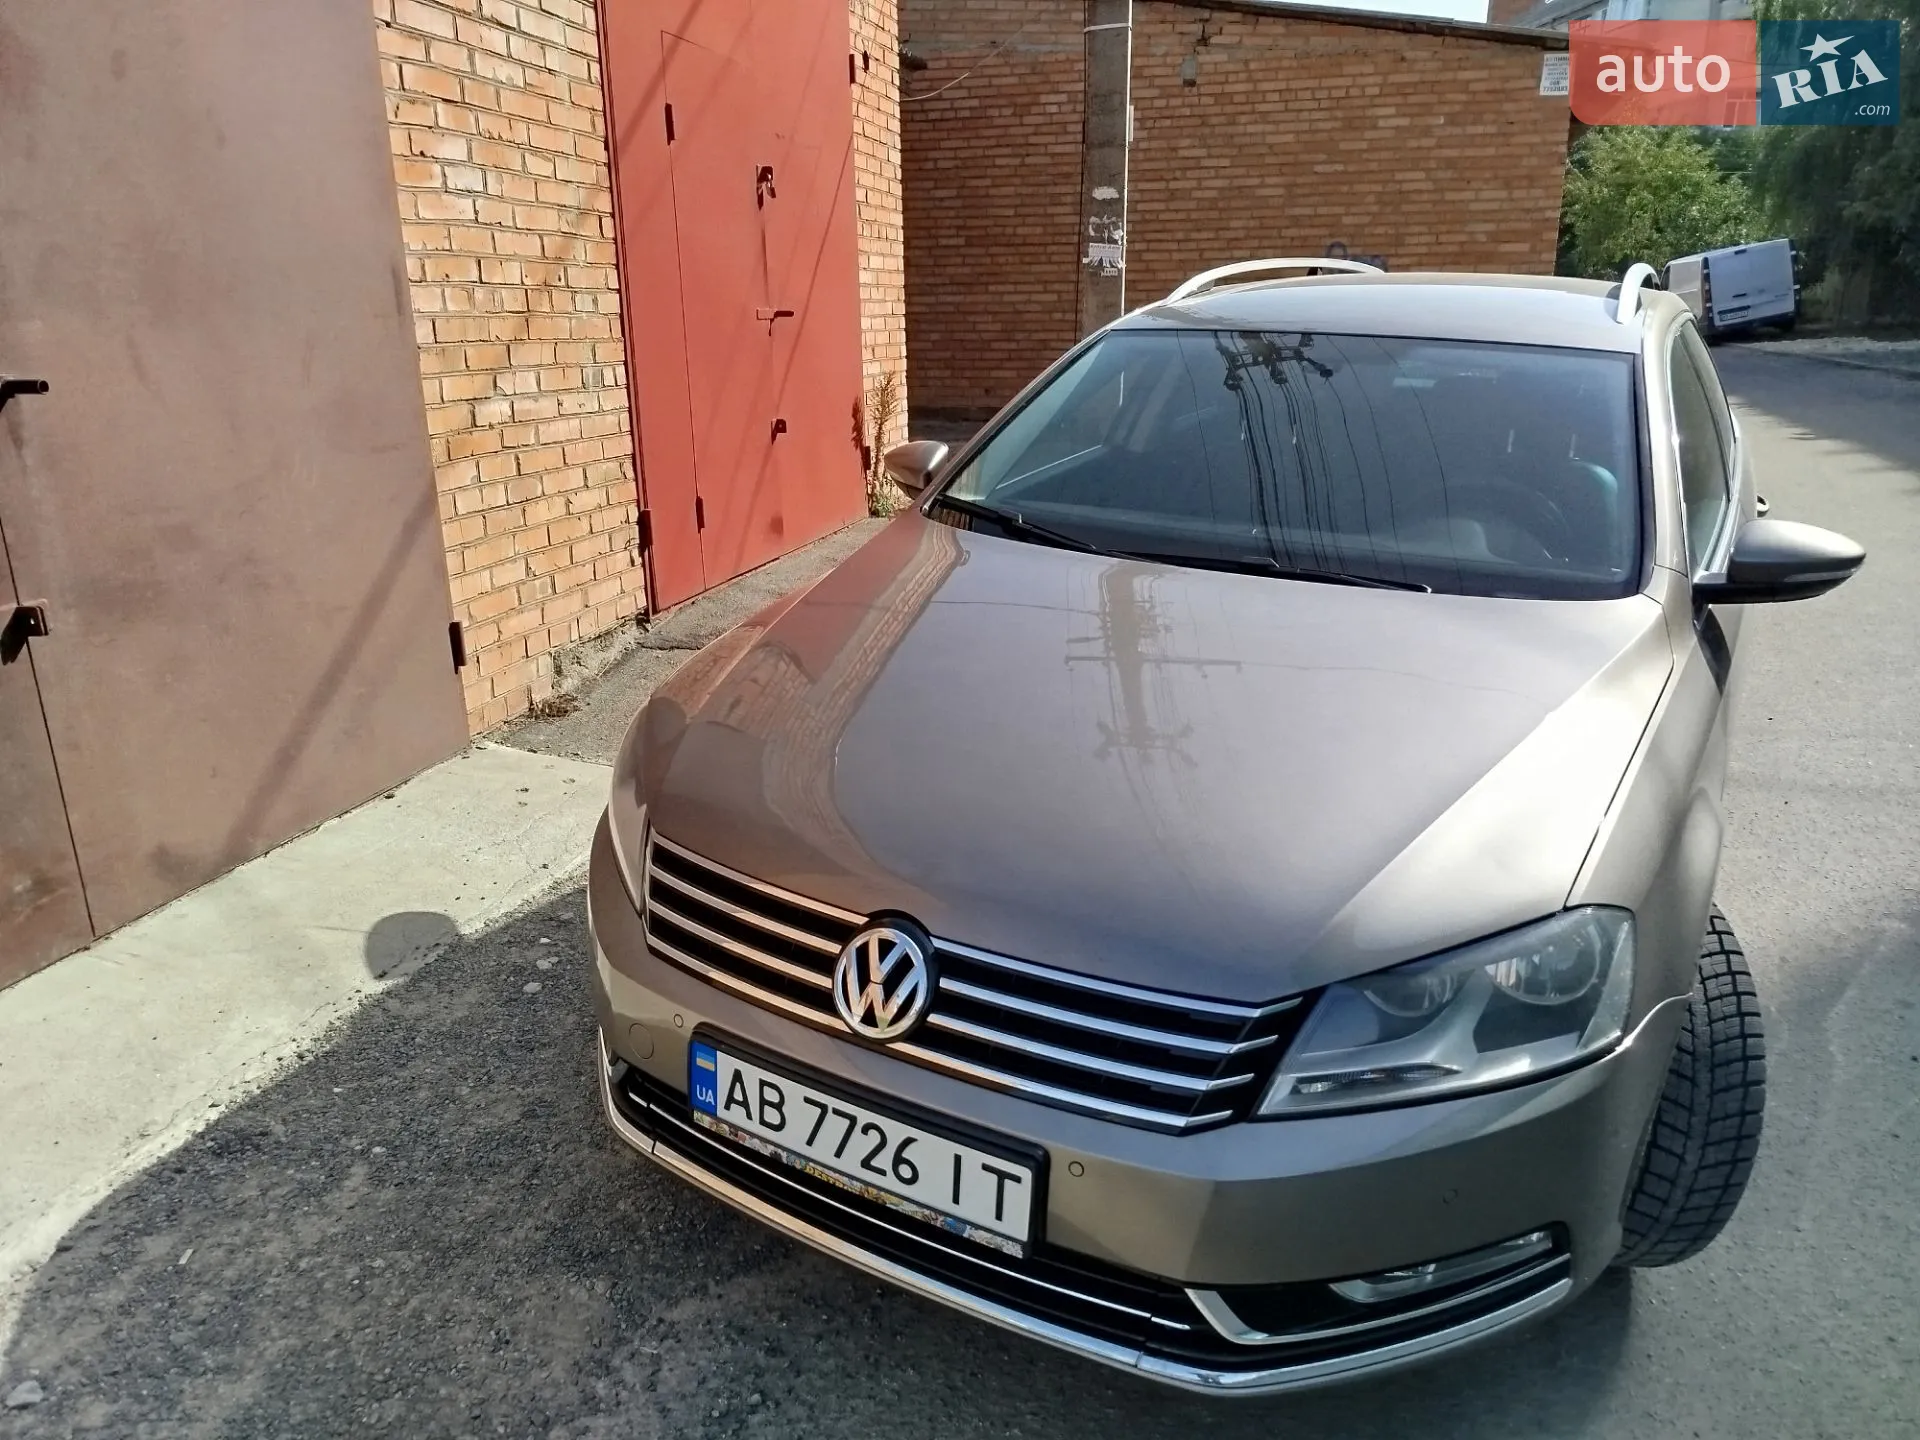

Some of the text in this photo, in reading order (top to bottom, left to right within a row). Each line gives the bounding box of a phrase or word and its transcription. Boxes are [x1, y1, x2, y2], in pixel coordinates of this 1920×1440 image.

[696, 1084, 715, 1106] UA
[723, 1067, 1023, 1223] AB 7726 IT
